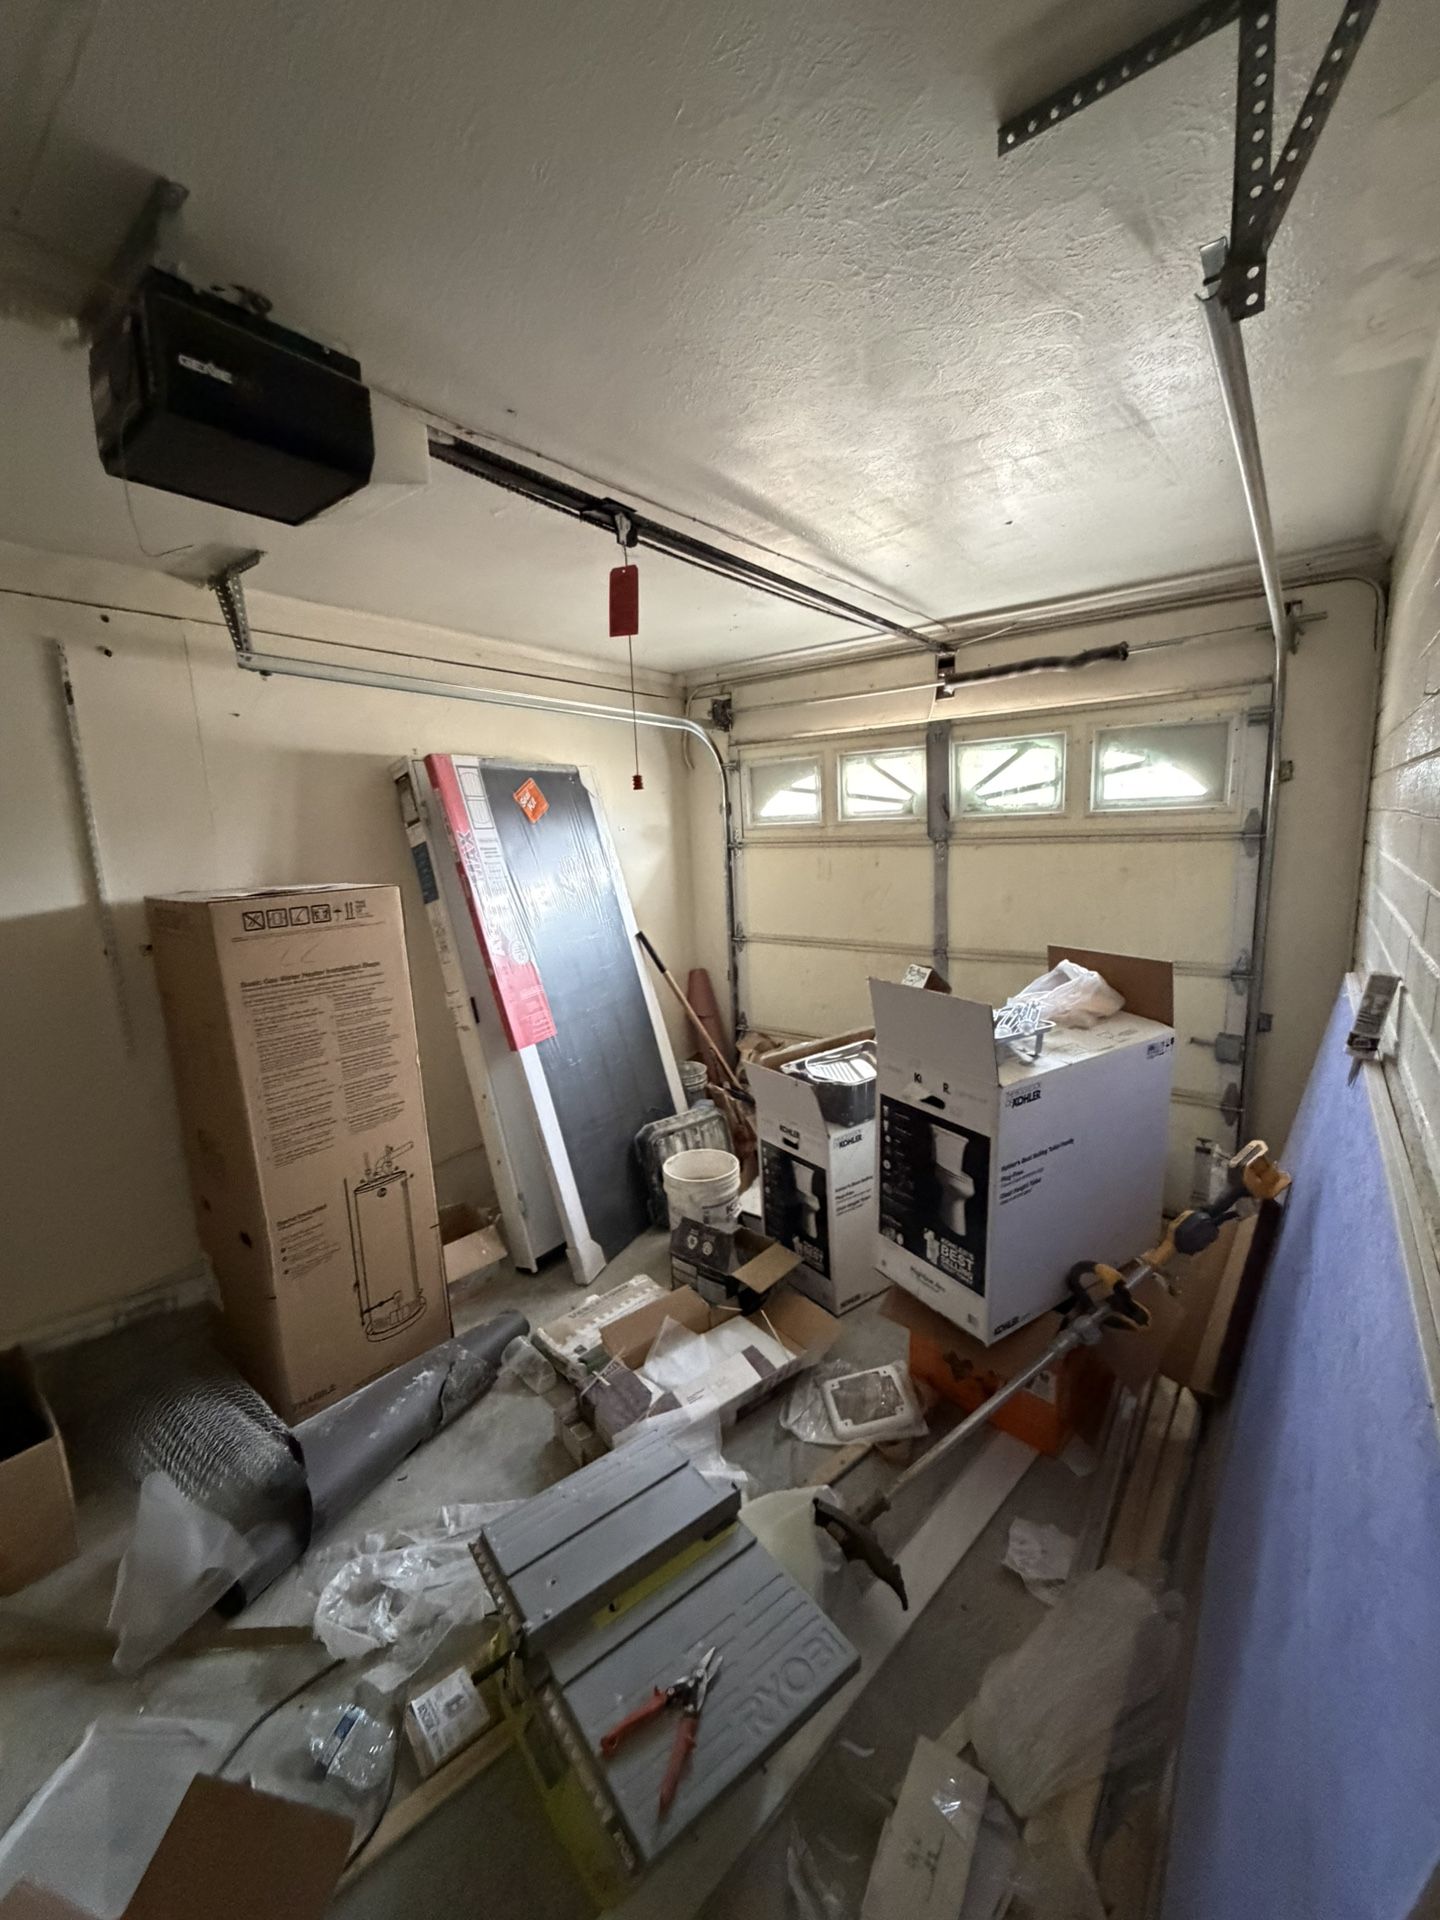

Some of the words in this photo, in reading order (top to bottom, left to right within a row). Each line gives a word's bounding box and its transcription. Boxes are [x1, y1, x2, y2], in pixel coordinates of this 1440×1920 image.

[1011, 1089, 1041, 1109] KOHLER
[838, 1134, 863, 1149] KOHLER
[940, 1244, 975, 1272] BEST
[732, 1626, 848, 1738] RYOBI
